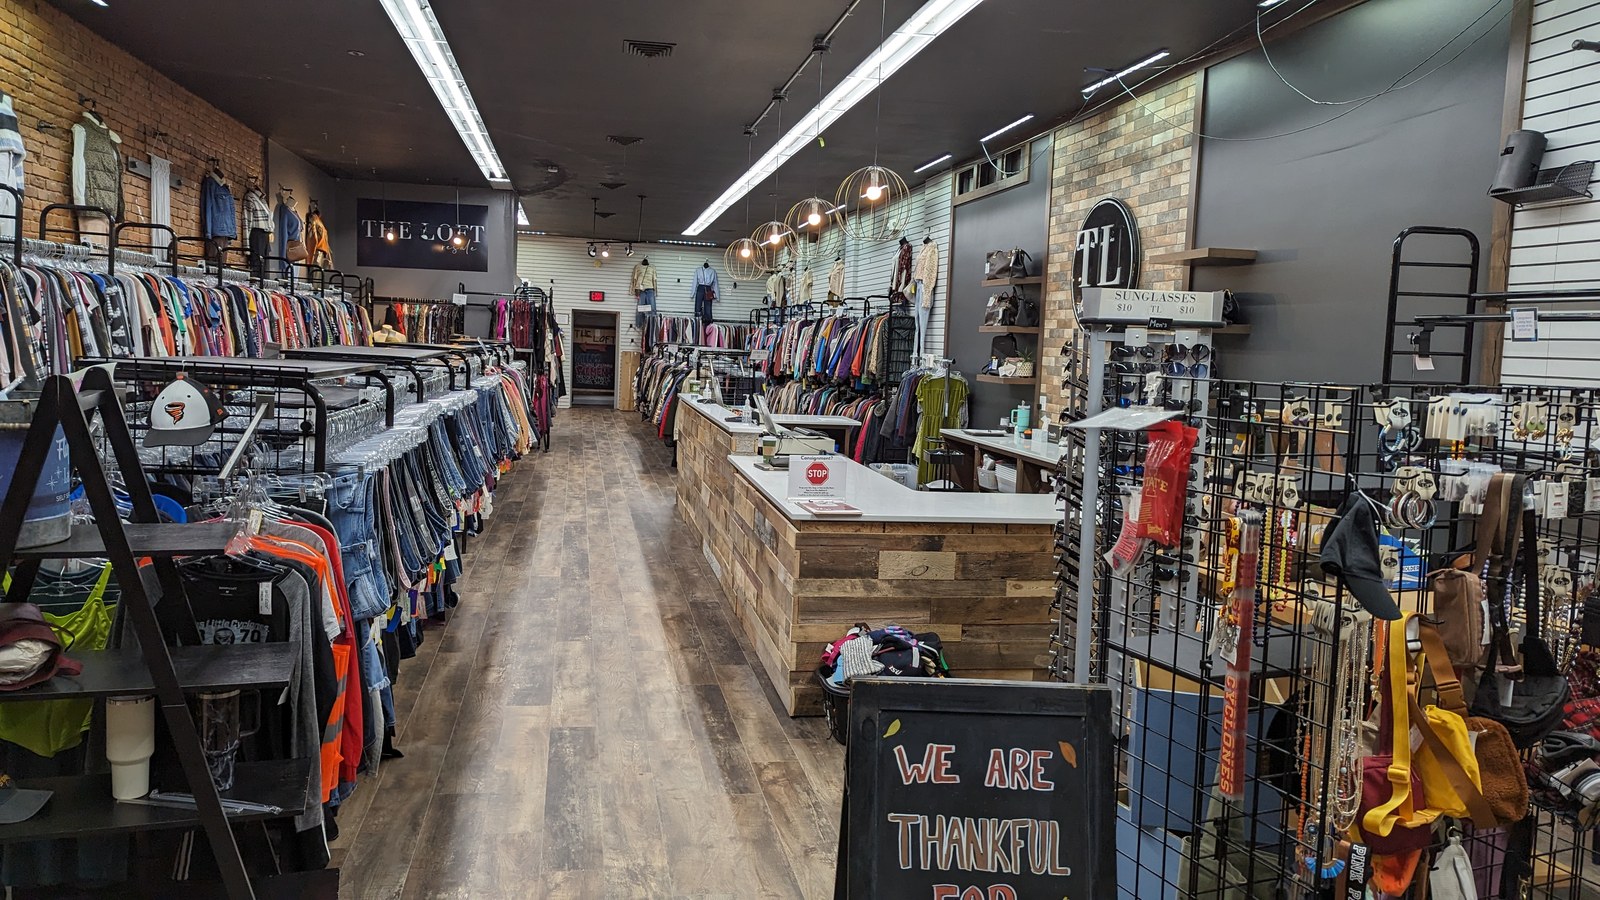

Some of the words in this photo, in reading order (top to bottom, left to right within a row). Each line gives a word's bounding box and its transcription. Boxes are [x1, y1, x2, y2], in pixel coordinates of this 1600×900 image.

[361, 219, 412, 239] THE
[421, 222, 485, 243] LOFT
[1077, 224, 1121, 288] TL
[1114, 290, 1197, 303] SUNGLASSES
[1116, 303, 1132, 312] $10
[1179, 306, 1195, 314] $10
[1149, 319, 1168, 328] Men's
[574, 329, 592, 338] THE
[593, 335, 615, 344] LOFT
[808, 469, 827, 478] STOP
[1144, 476, 1169, 493] TATE
[205, 619, 230, 629] Little
[1220, 674, 1236, 795] CYCLONES
[893, 743, 960, 785] WE
[984, 747, 1055, 791] ARE
[888, 812, 1071, 876] THANKFUL
[1350, 844, 1367, 884] PINK
